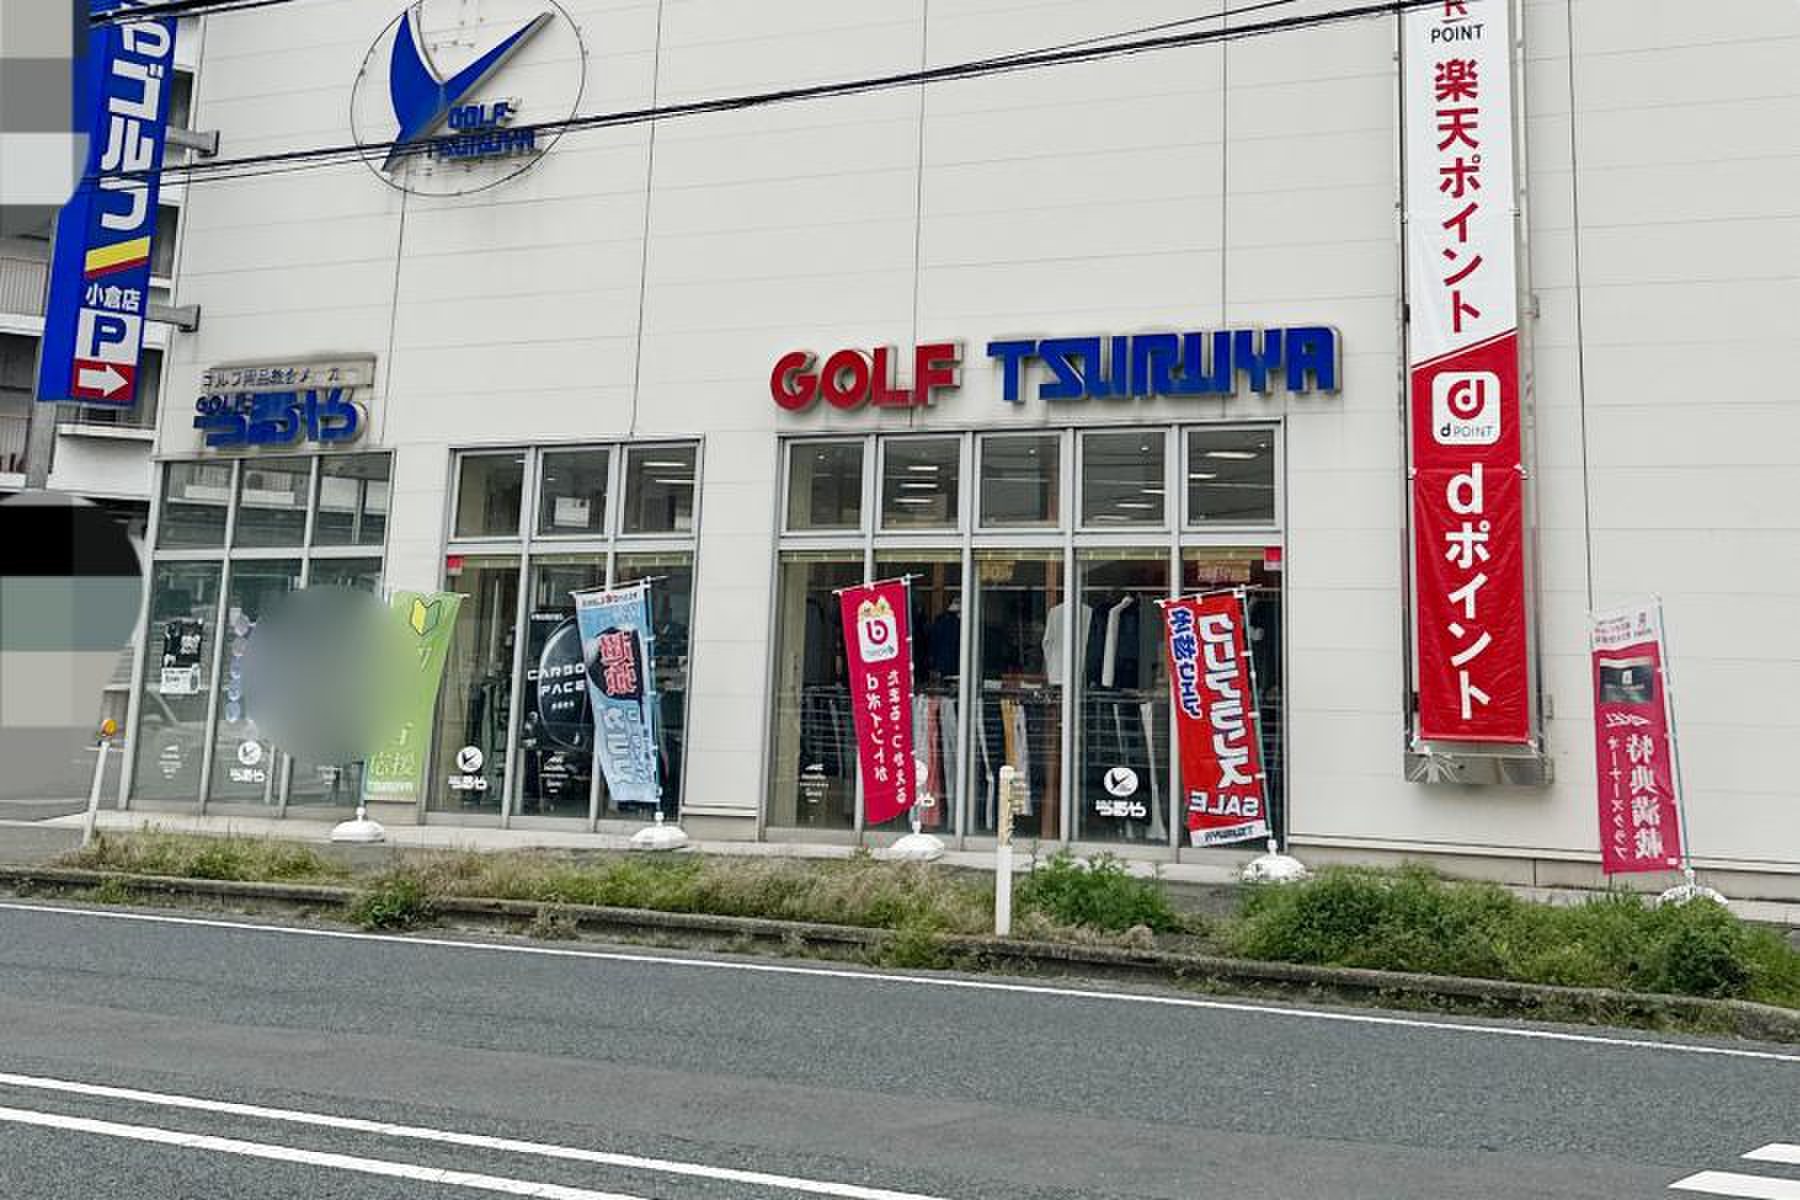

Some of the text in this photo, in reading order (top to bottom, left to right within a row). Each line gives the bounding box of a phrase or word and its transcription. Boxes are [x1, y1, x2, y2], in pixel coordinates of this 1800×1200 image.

[1431, 24, 1484, 43] POINT
[448, 100, 515, 131] GOLF
[1434, 58, 1483, 333] 楽天ポイント
[85, 283, 140, 312] 小倉店
[90, 315, 127, 357] P
[769, 326, 1338, 410] GOLF TSURUYA
[193, 387, 362, 447] つるや
[1445, 462, 1493, 721] dポイント
[528, 663, 586, 681] CARBO
